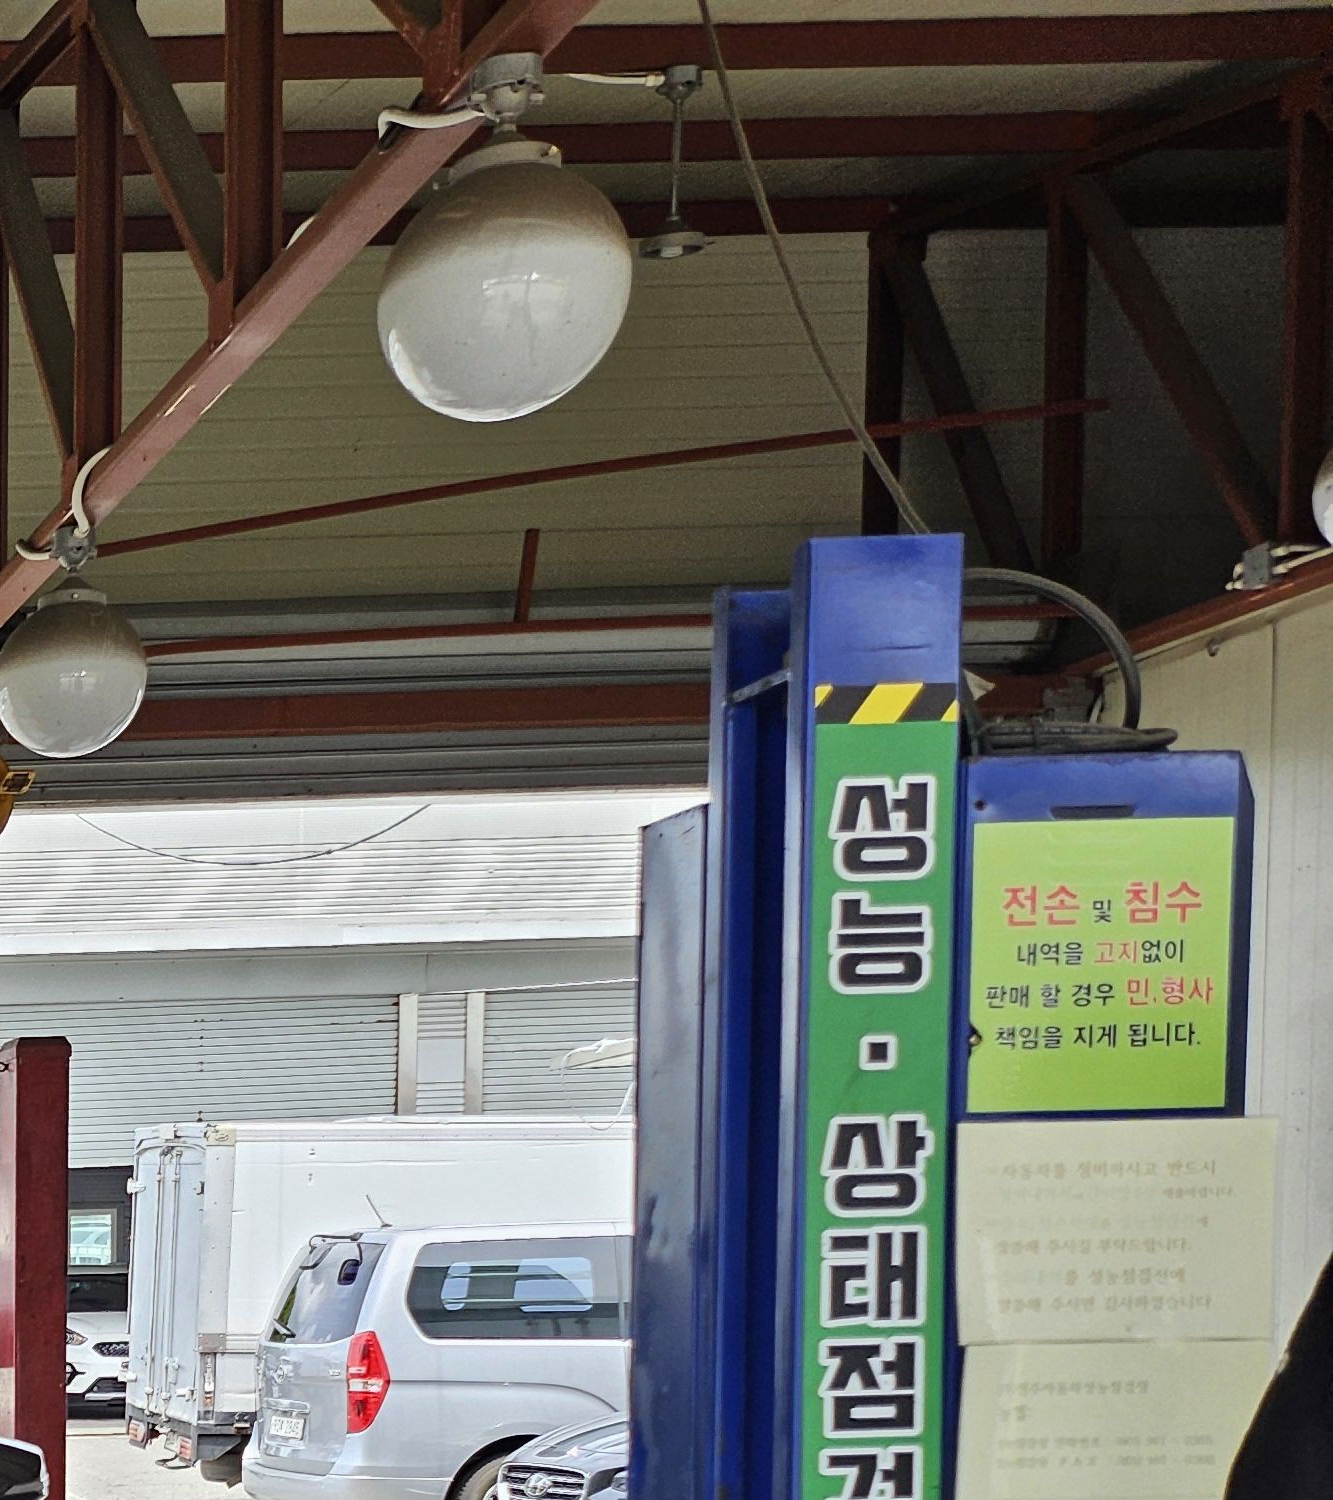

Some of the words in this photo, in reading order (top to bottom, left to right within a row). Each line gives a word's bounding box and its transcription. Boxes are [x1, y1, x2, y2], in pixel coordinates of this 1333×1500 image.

[1002, 885, 1080, 926] 전손
[1092, 899, 1112, 923] 및
[1125, 881, 1202, 924] 침수
[1017, 942, 1083, 967] 내역을
[1094, 939, 1184, 964] 고지없이
[985, 985, 1029, 1009] 판매
[1040, 984, 1061, 1008] 할
[1071, 983, 1115, 1007] 경우
[995, 1026, 1063, 1050] 책임을
[1073, 1024, 1117, 1048] 지게
[1127, 1022, 1201, 1048] 됩니다.
